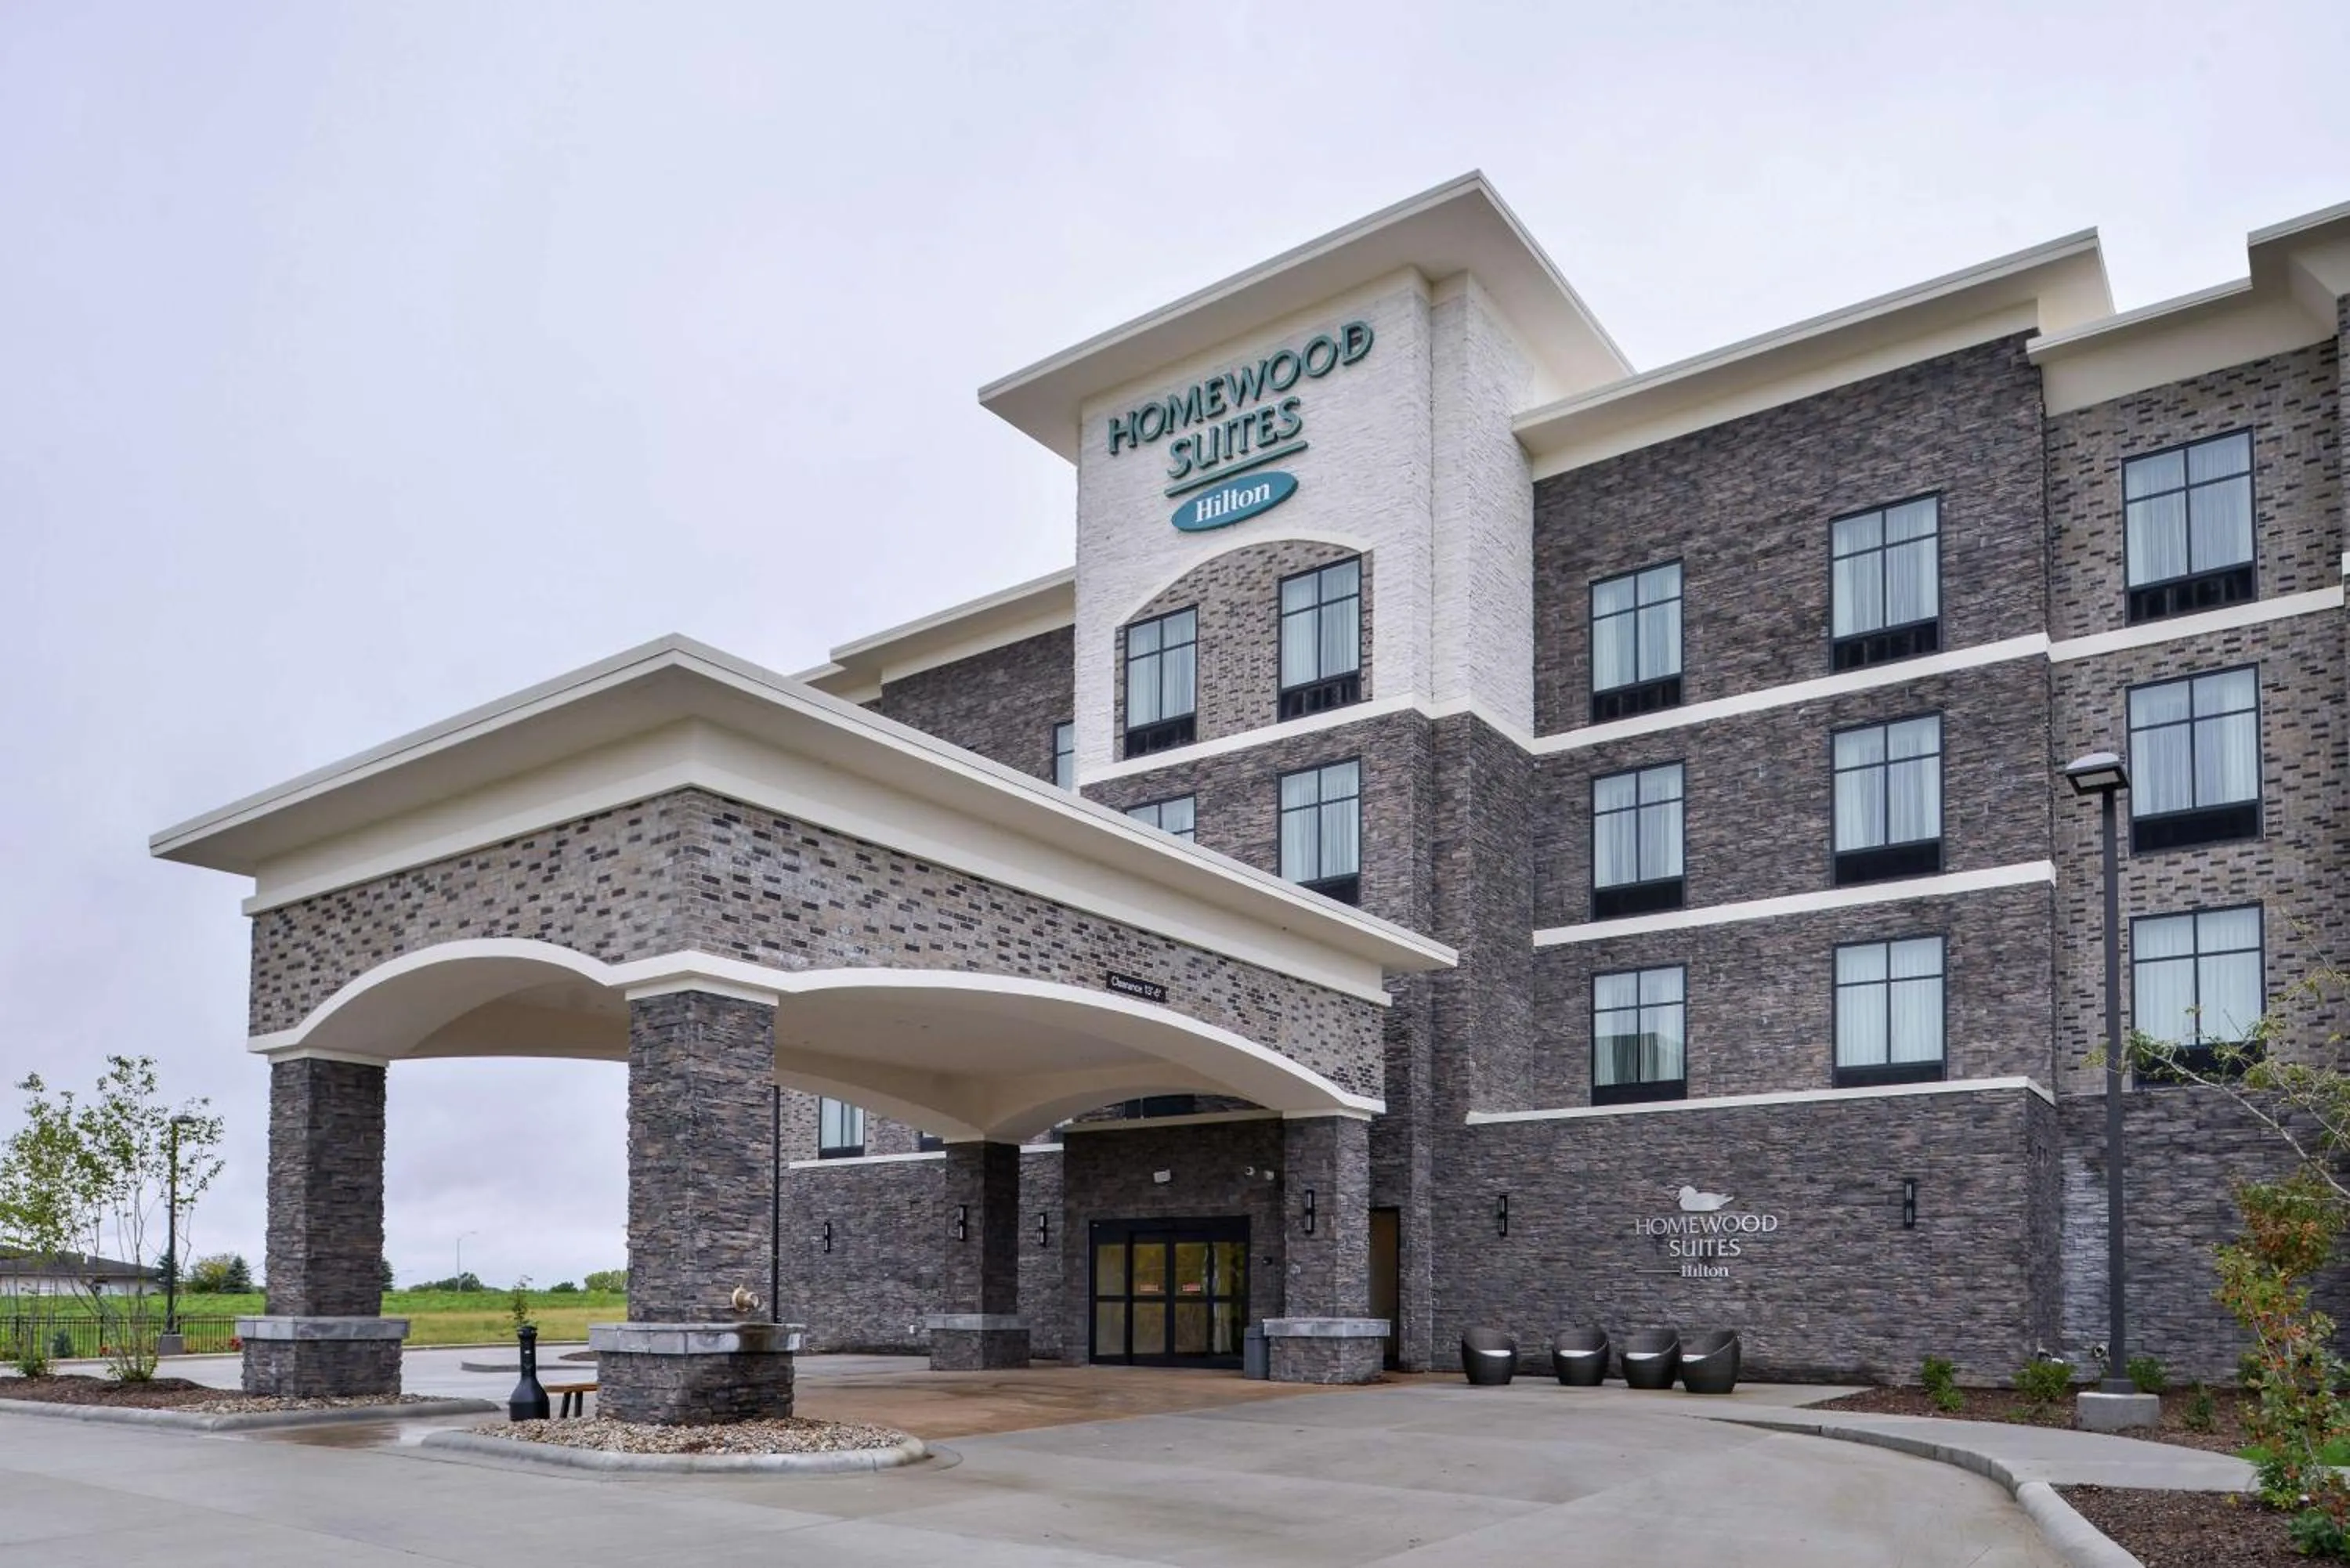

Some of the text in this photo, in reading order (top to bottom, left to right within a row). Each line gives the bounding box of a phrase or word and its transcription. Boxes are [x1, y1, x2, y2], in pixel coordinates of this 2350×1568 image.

[1108, 320, 1374, 454] HOMEWOOD
[1167, 396, 1302, 479] SUITES
[1195, 482, 1271, 523] Hilton
[1636, 1215, 1777, 1235] HOMEWOOD
[1668, 1238, 1741, 1257] SUITES
[1681, 1263, 1729, 1277] Hilton
